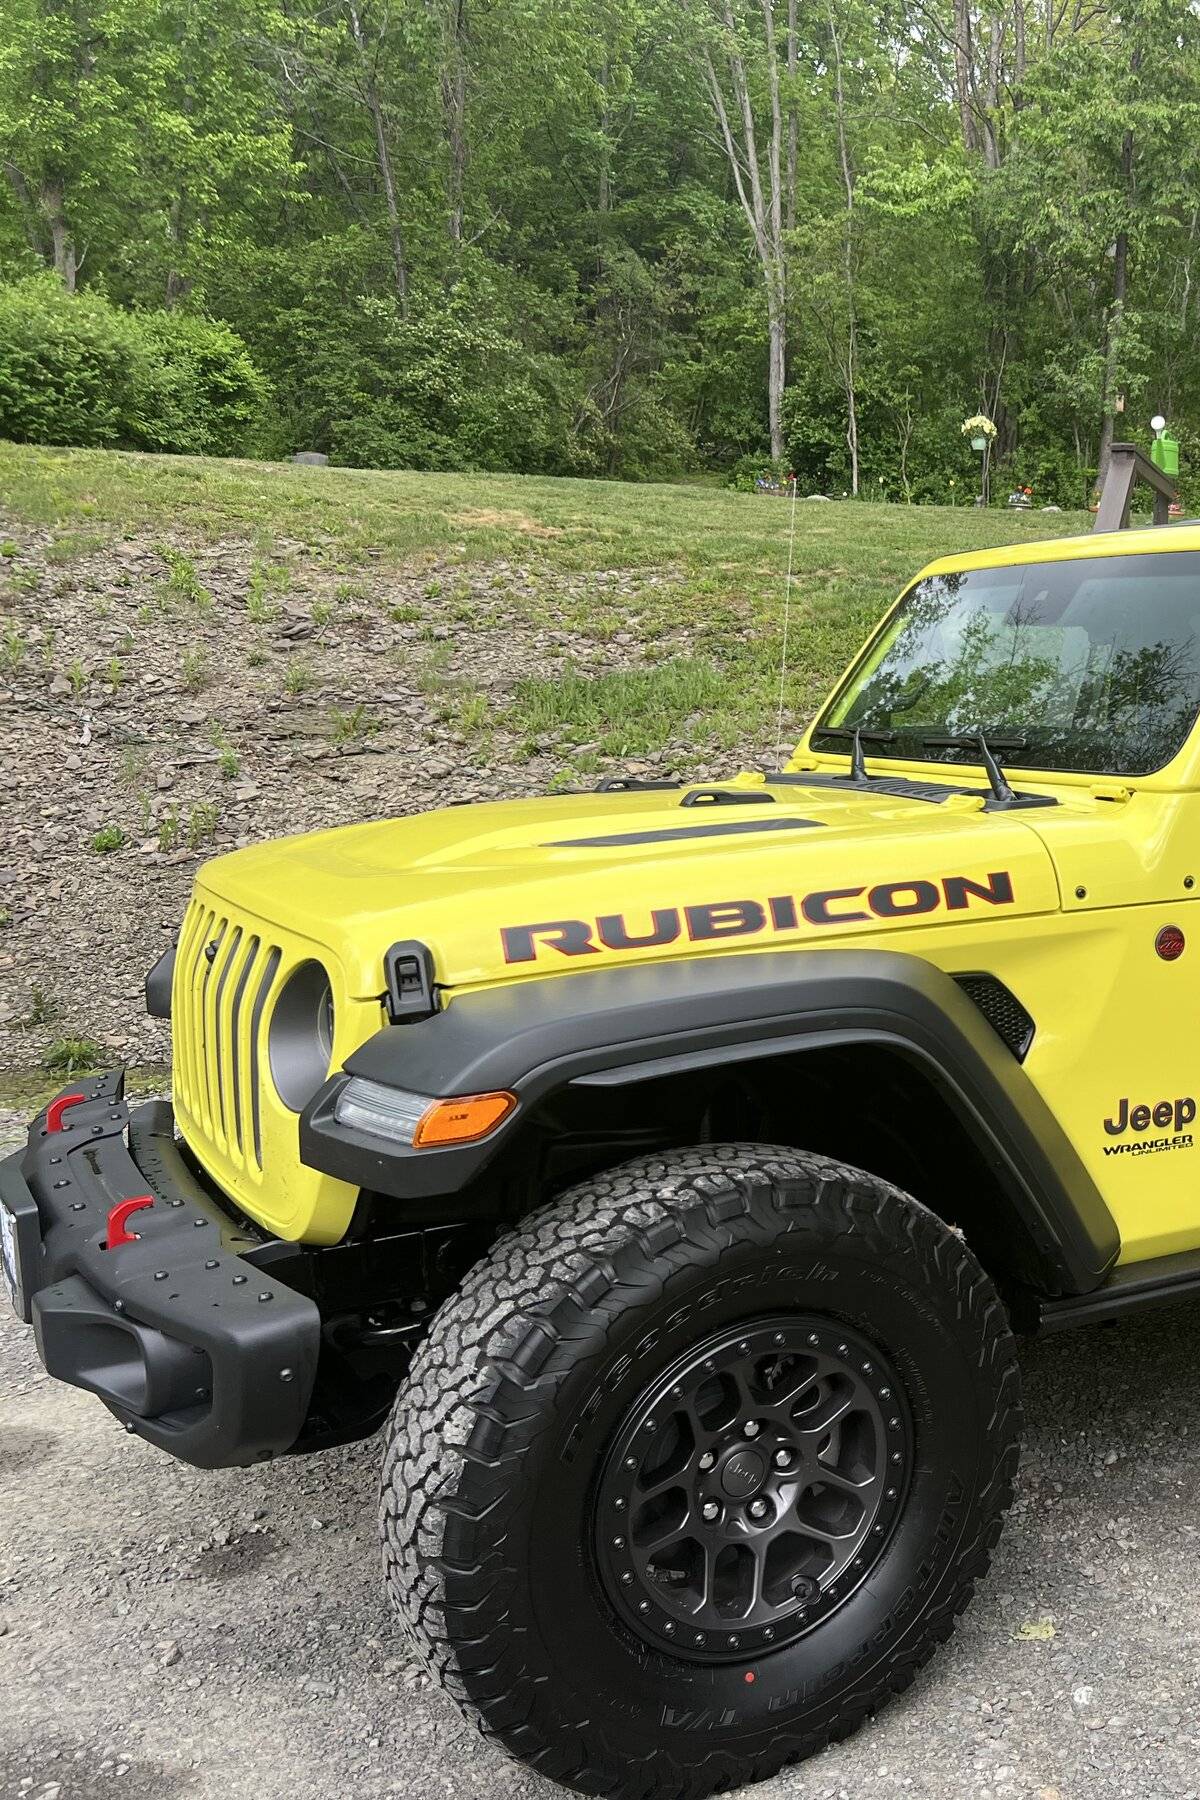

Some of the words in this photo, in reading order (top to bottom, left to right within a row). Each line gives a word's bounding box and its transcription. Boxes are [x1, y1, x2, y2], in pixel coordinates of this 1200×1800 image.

[499, 871, 1016, 965] RUBICON
[1103, 1097, 1196, 1135] Jeep
[1103, 1134, 1193, 1156] WRANGLER
[1131, 1142, 1194, 1156] UNLIMITED
